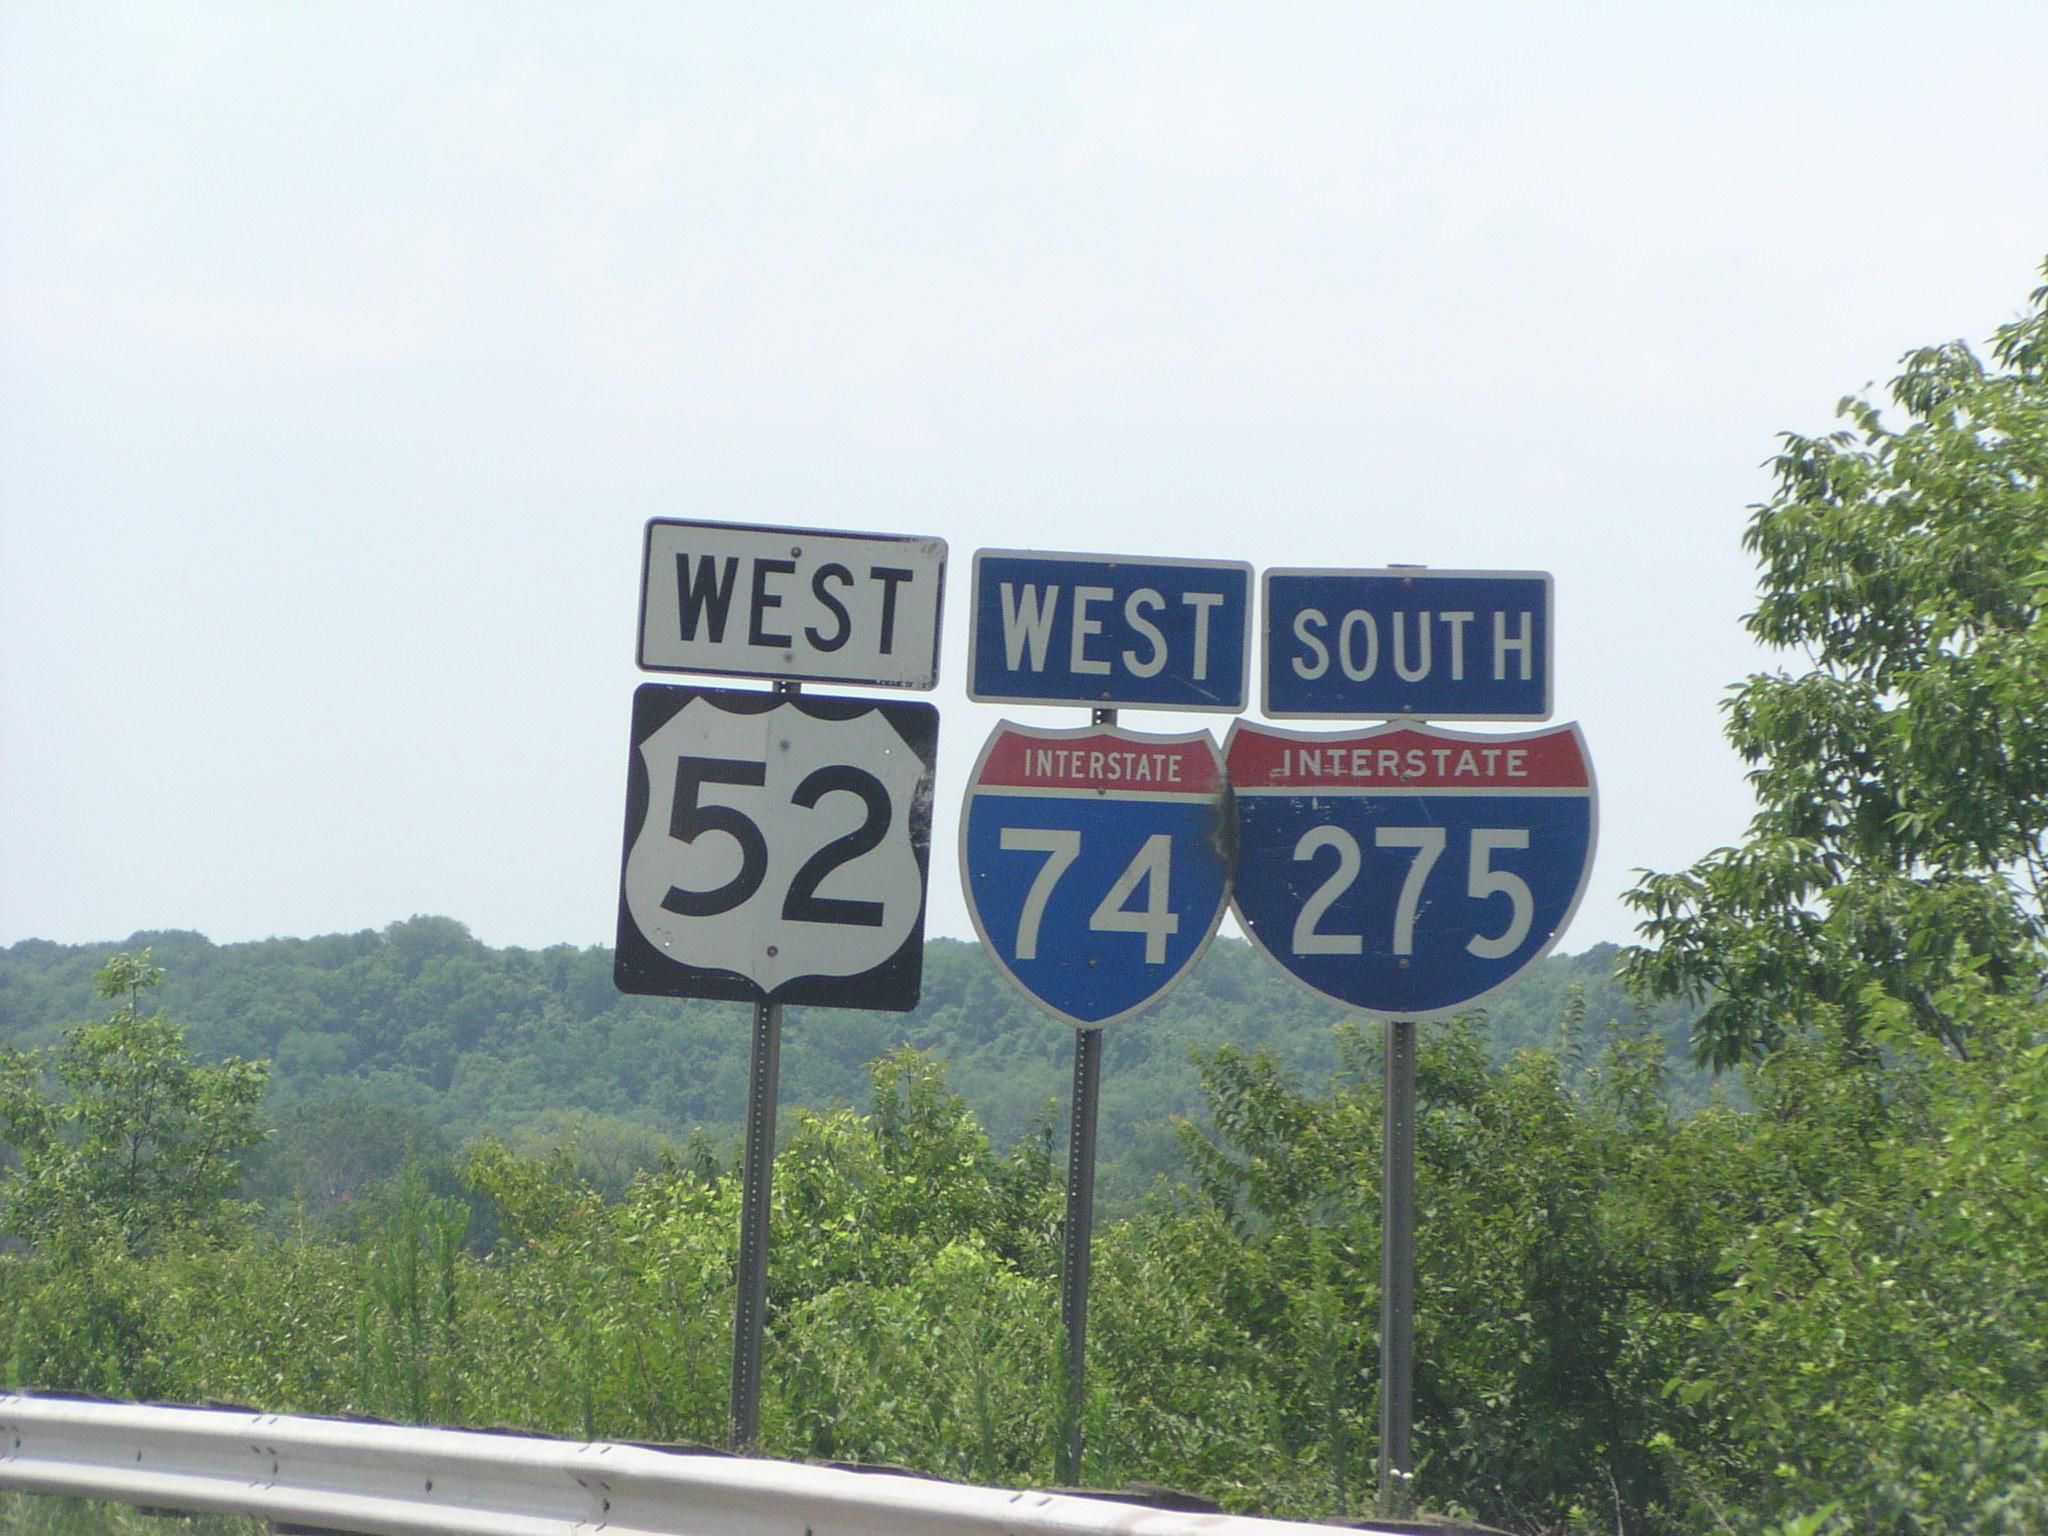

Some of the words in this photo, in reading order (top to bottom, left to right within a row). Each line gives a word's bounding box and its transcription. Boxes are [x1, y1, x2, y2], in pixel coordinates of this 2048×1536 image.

[676, 552, 913, 655] WEST
[1000, 582, 1224, 680] WEST
[1291, 608, 1533, 682] SOUTH
[1024, 749, 1183, 783] INTERSTATE
[1283, 749, 1528, 778] INTERSTATE
[659, 755, 892, 928] 52
[1000, 827, 1179, 964] 74
[1292, 825, 1534, 960] 275
